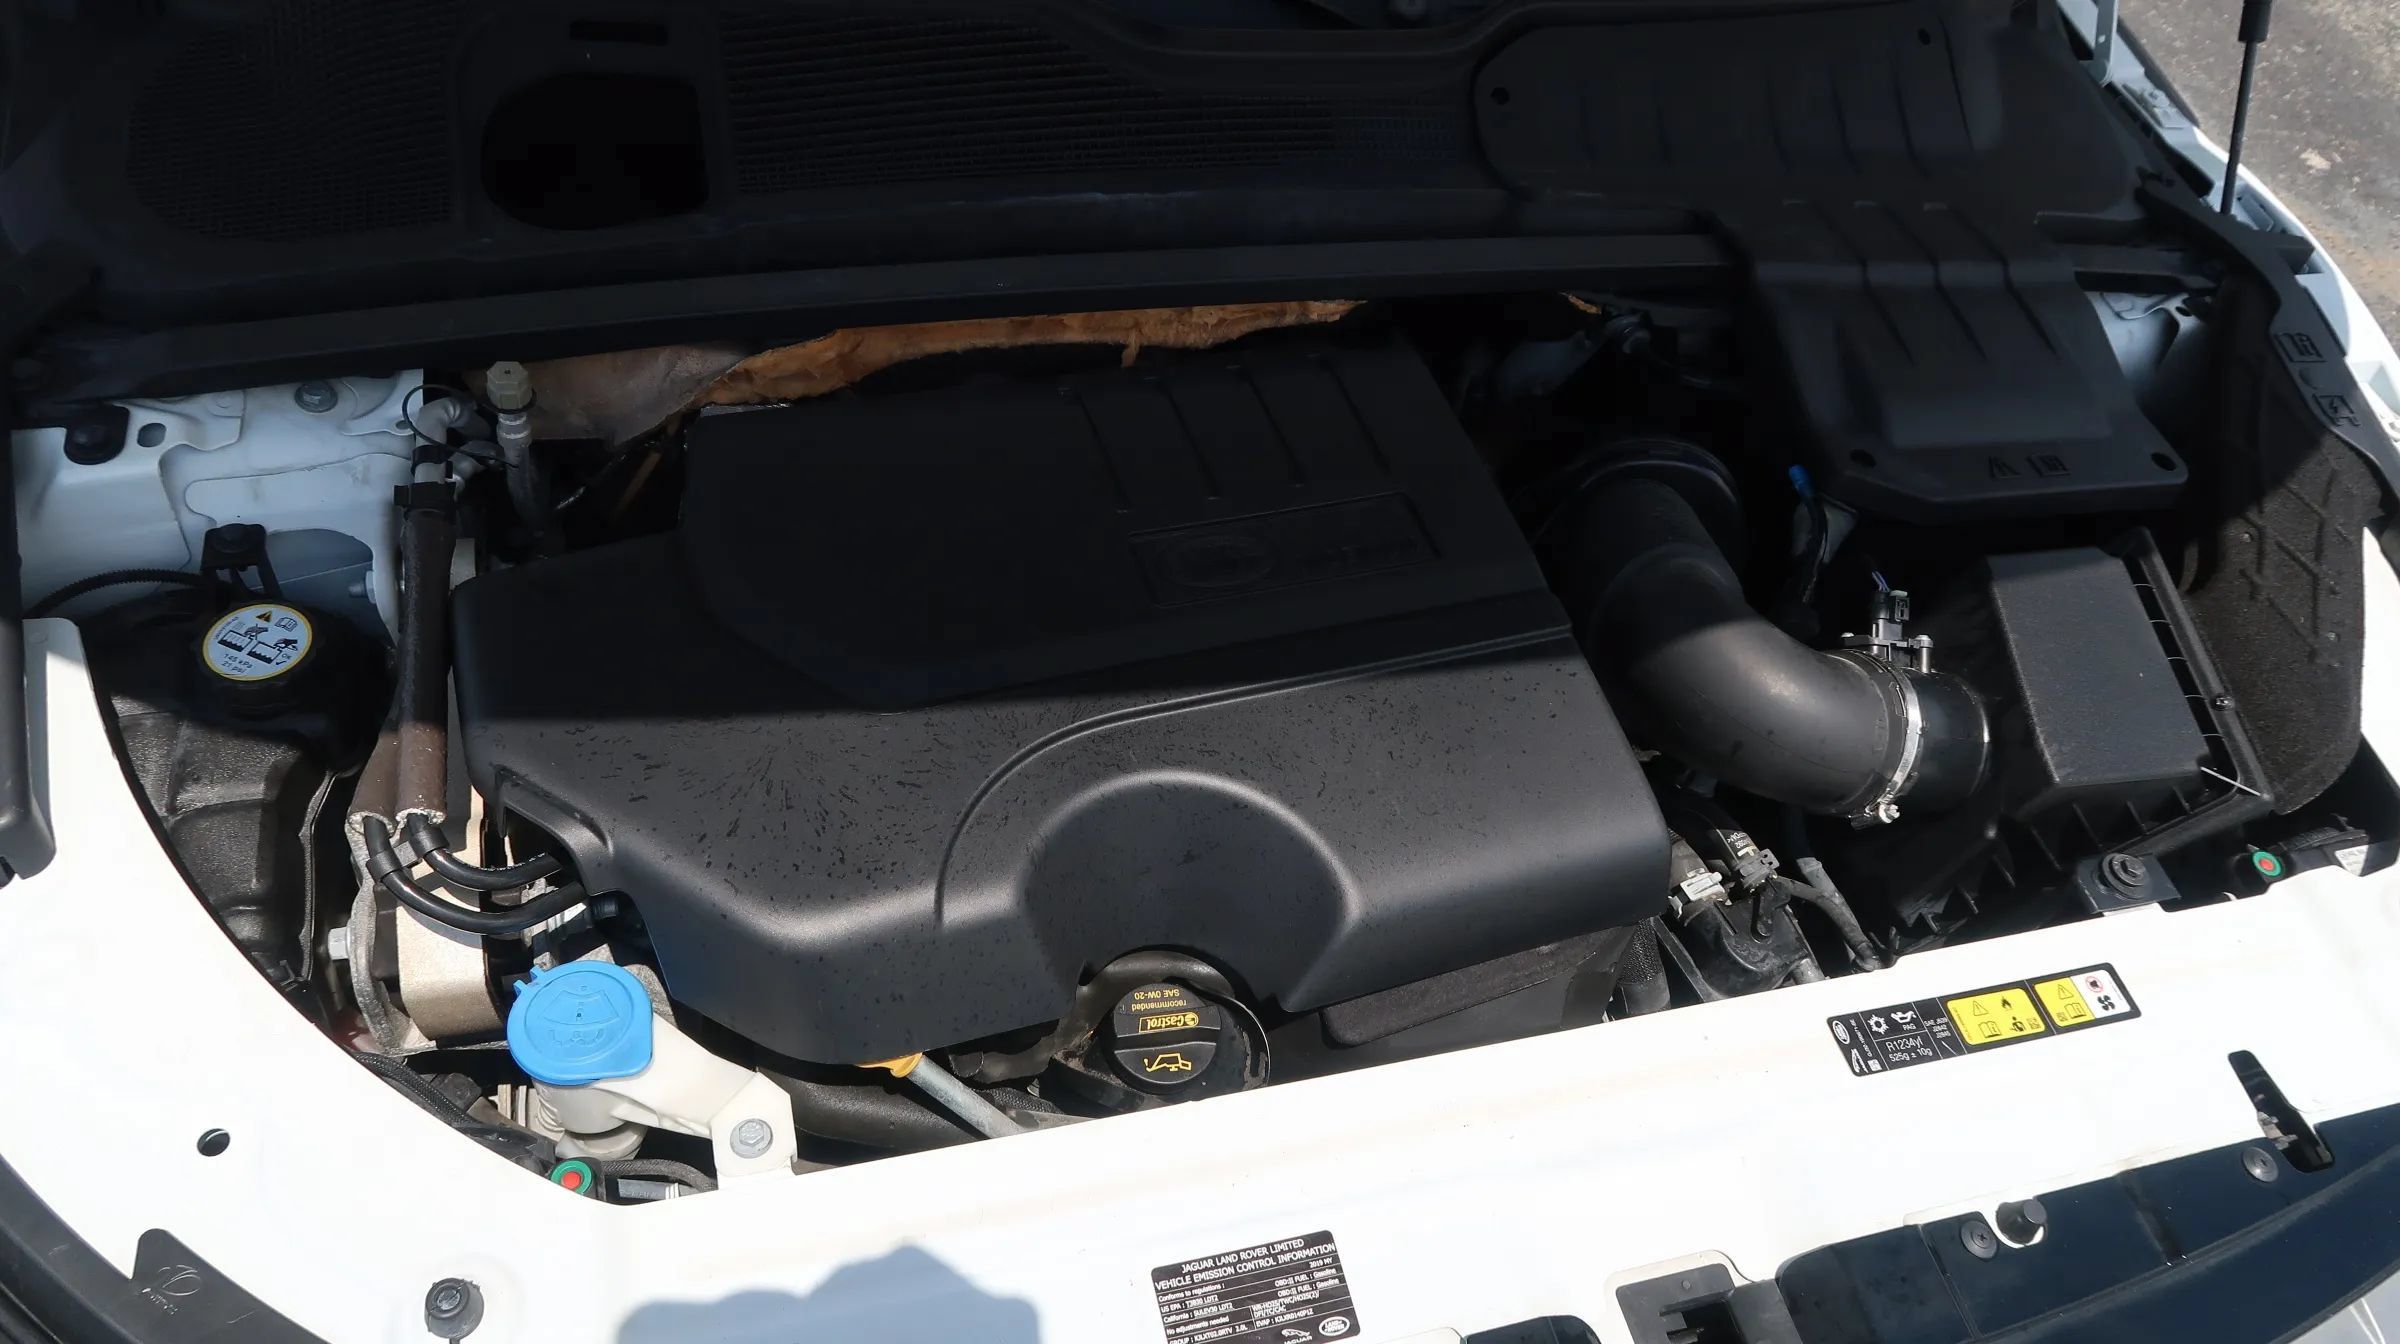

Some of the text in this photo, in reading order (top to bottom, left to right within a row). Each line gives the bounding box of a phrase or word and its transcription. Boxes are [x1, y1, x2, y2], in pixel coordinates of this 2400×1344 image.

[1134, 989, 1180, 1000] SAE 0W-20
[1131, 1000, 1187, 1012] recommended
[1147, 1016, 1184, 1029] Castrol
[1885, 1035, 1924, 1053] R1234yf
[1889, 1051, 1910, 1063] 525g
[1916, 1046, 1933, 1057] 10g
[1181, 1239, 1304, 1272] JAGUAR LAND ROVER LIMITED
[1156, 1243, 1335, 1290] VEHICLE EMISSION CONTROL INFORMATION
[1295, 1274, 1309, 1282] FUEL
[1313, 1268, 1336, 1278] Gasoline
[1159, 1291, 1184, 1302] Conforms
[1192, 1283, 1221, 1295] regulations
[1298, 1284, 1311, 1292] FUEL
[1316, 1278, 1339, 1288] Gasoline
[1164, 1312, 1188, 1323] California
[1193, 1305, 1218, 1316] SULEV30
[1256, 1318, 1270, 1327] EVAP
[1175, 1320, 1209, 1334] adjustments
[1209, 1315, 1229, 1325] needed
